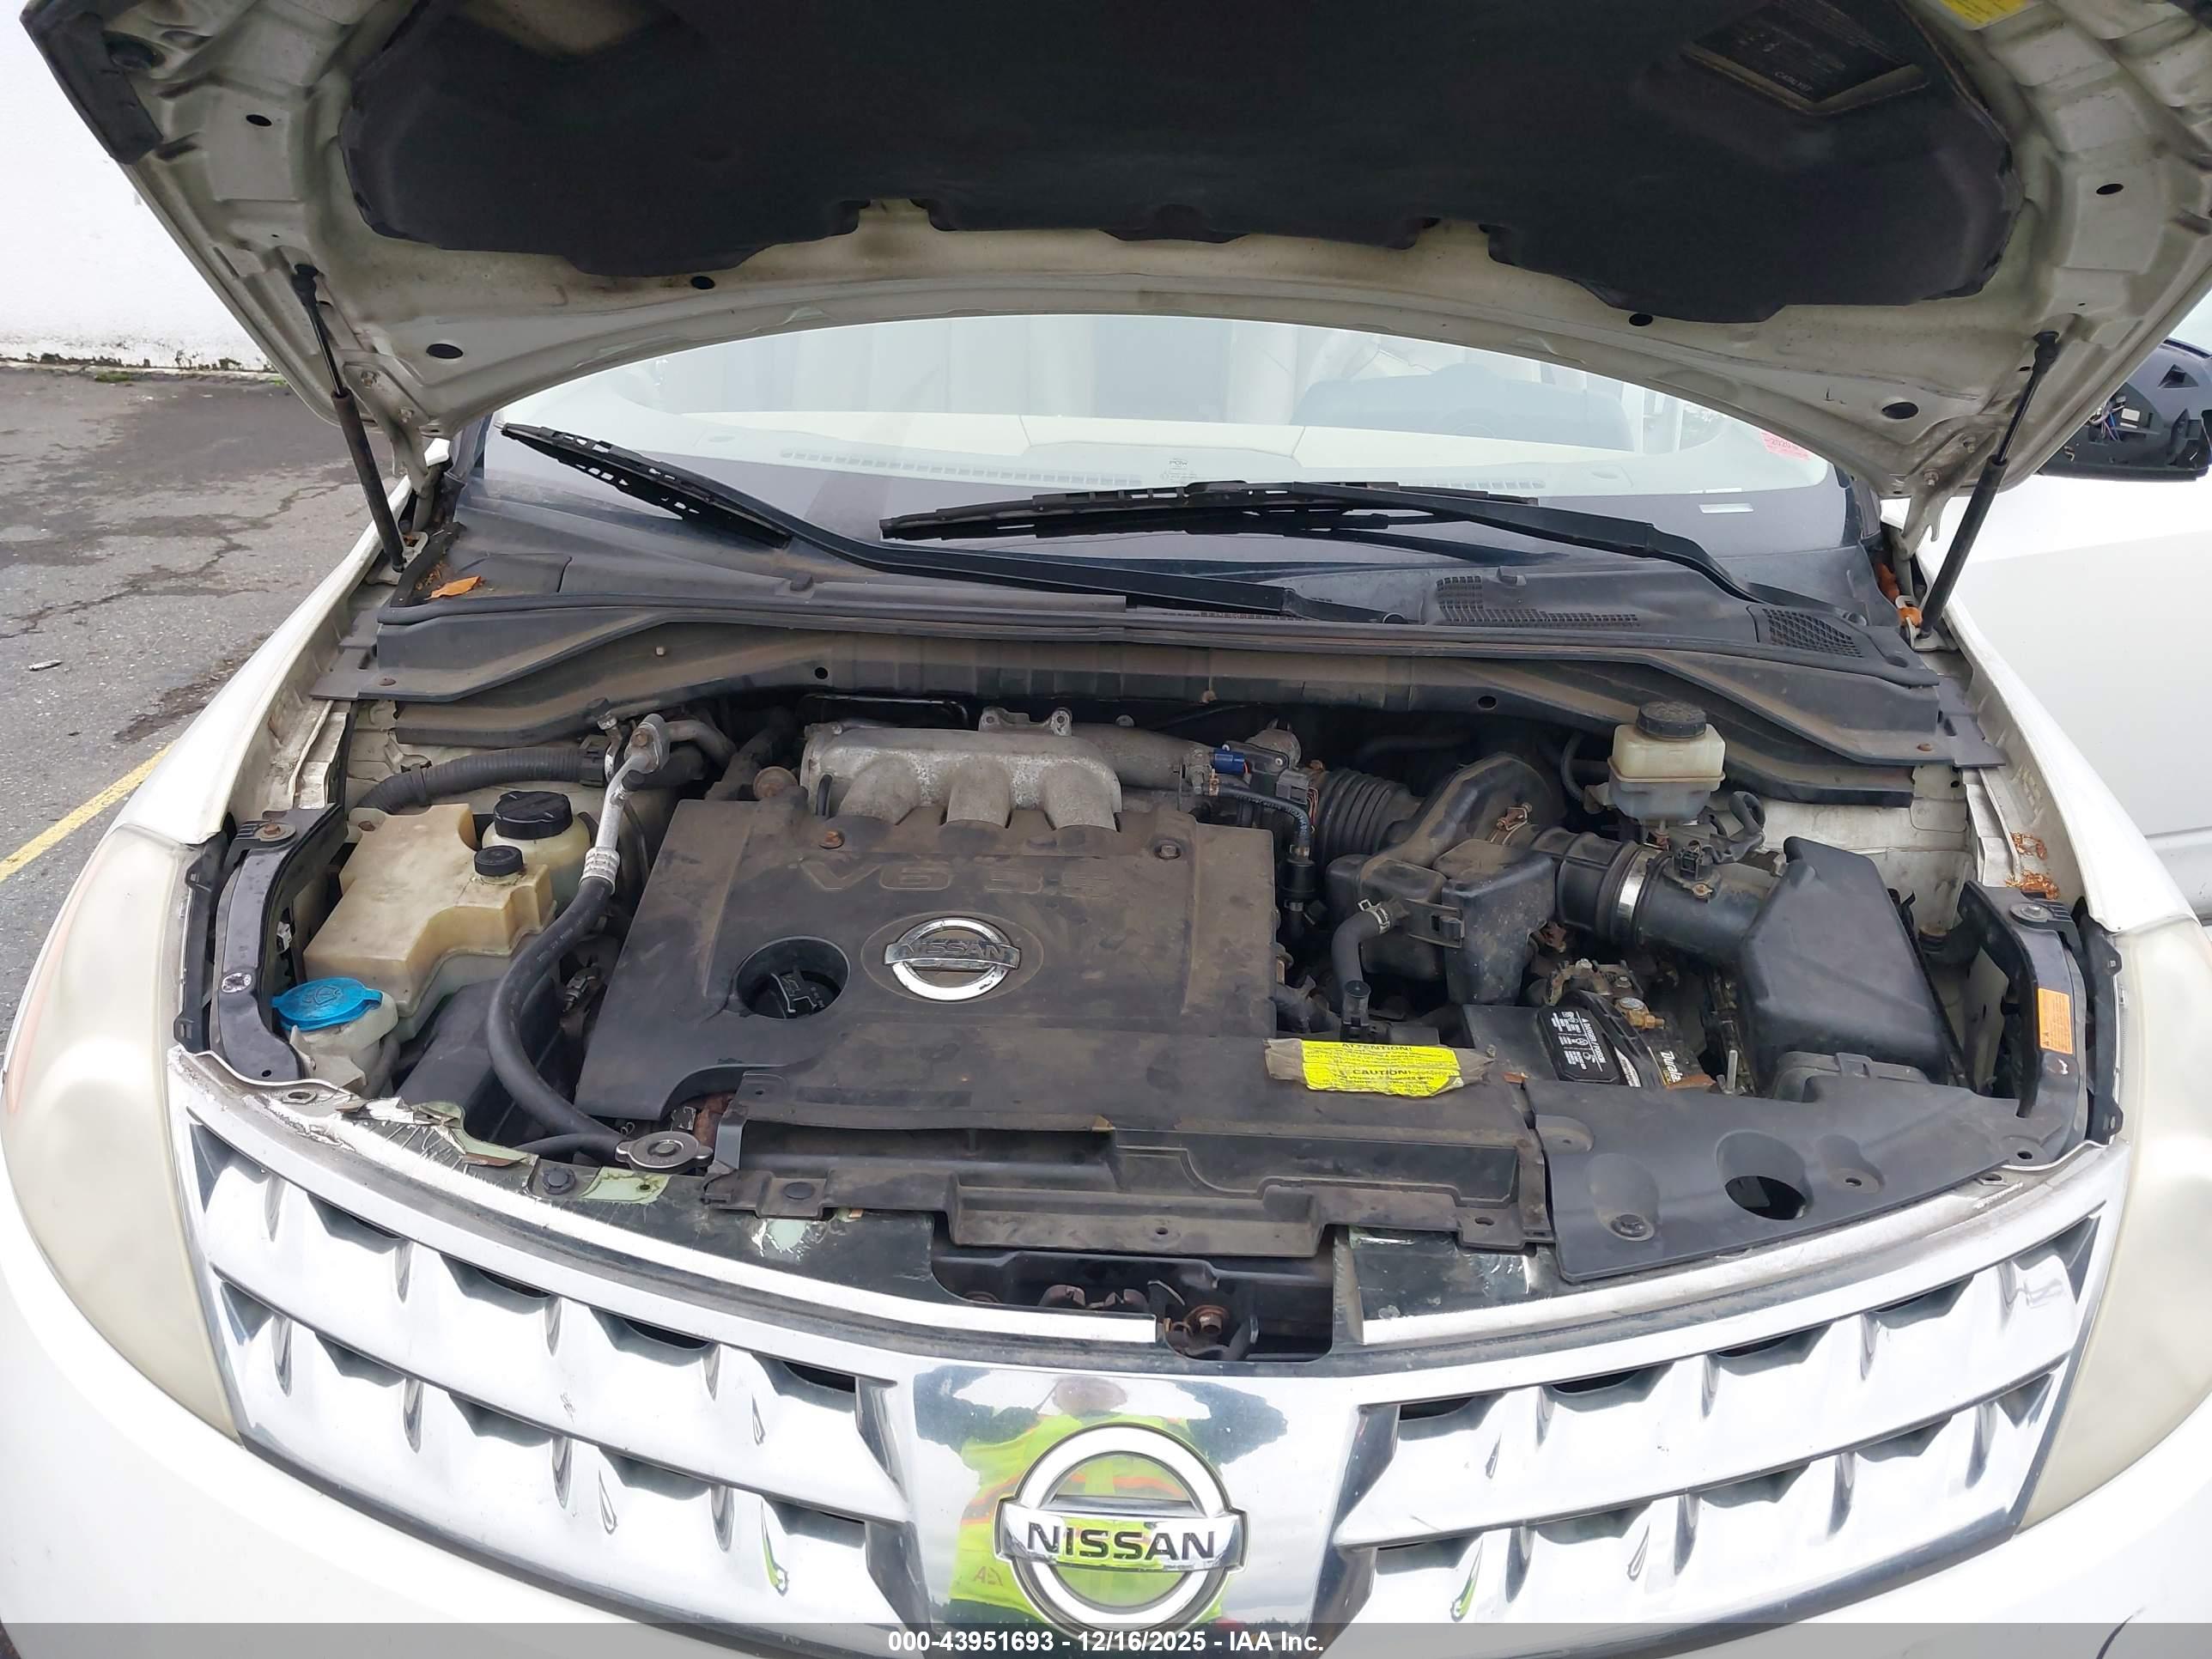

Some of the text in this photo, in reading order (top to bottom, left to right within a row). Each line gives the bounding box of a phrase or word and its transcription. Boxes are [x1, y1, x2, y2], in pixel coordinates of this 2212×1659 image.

[905, 941, 1005, 958] NISSAN
[1341, 1043, 1413, 1052] ATTENTION!
[1352, 1068, 1411, 1077] CAUTION!
[1660, 1050, 1683, 1084] Durala
[1027, 1521, 1215, 1561] NISSAN
